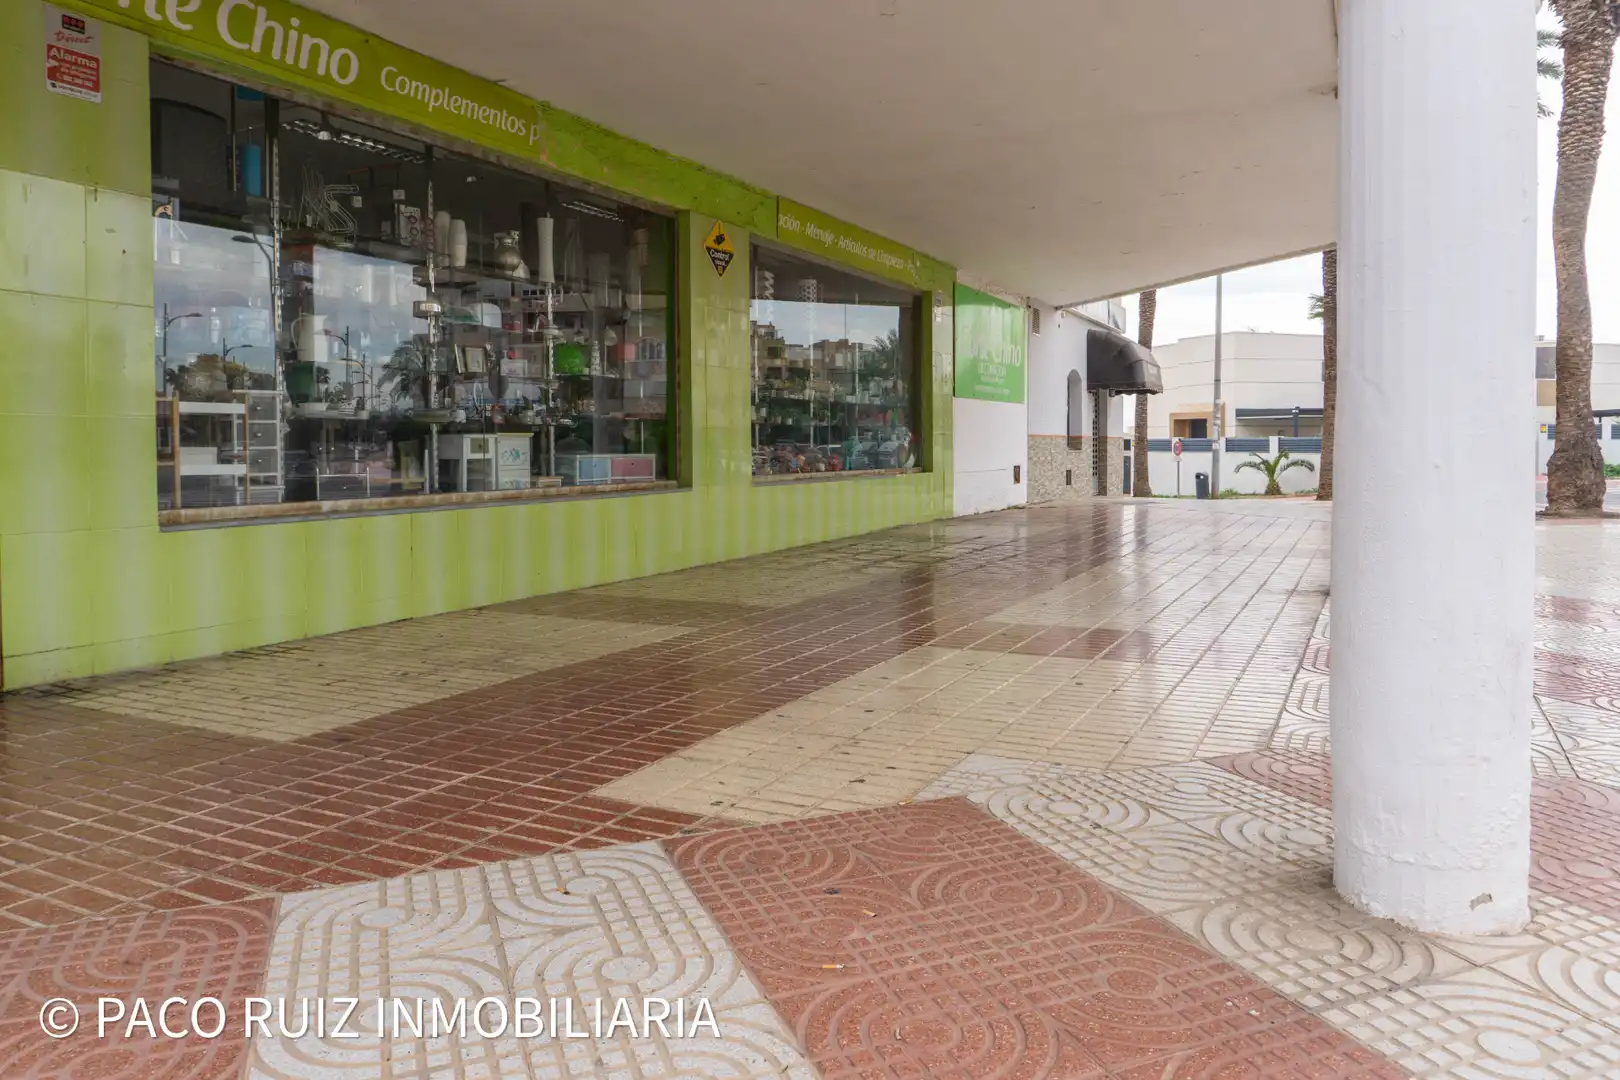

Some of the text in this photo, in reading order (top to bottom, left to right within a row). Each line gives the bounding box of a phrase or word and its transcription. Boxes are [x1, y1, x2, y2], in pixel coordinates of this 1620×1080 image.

[50, 47, 97, 68] Alarma
[216, 0, 359, 85] Chino
[381, 66, 527, 137] Complementos
[804, 222, 835, 248] Menaje
